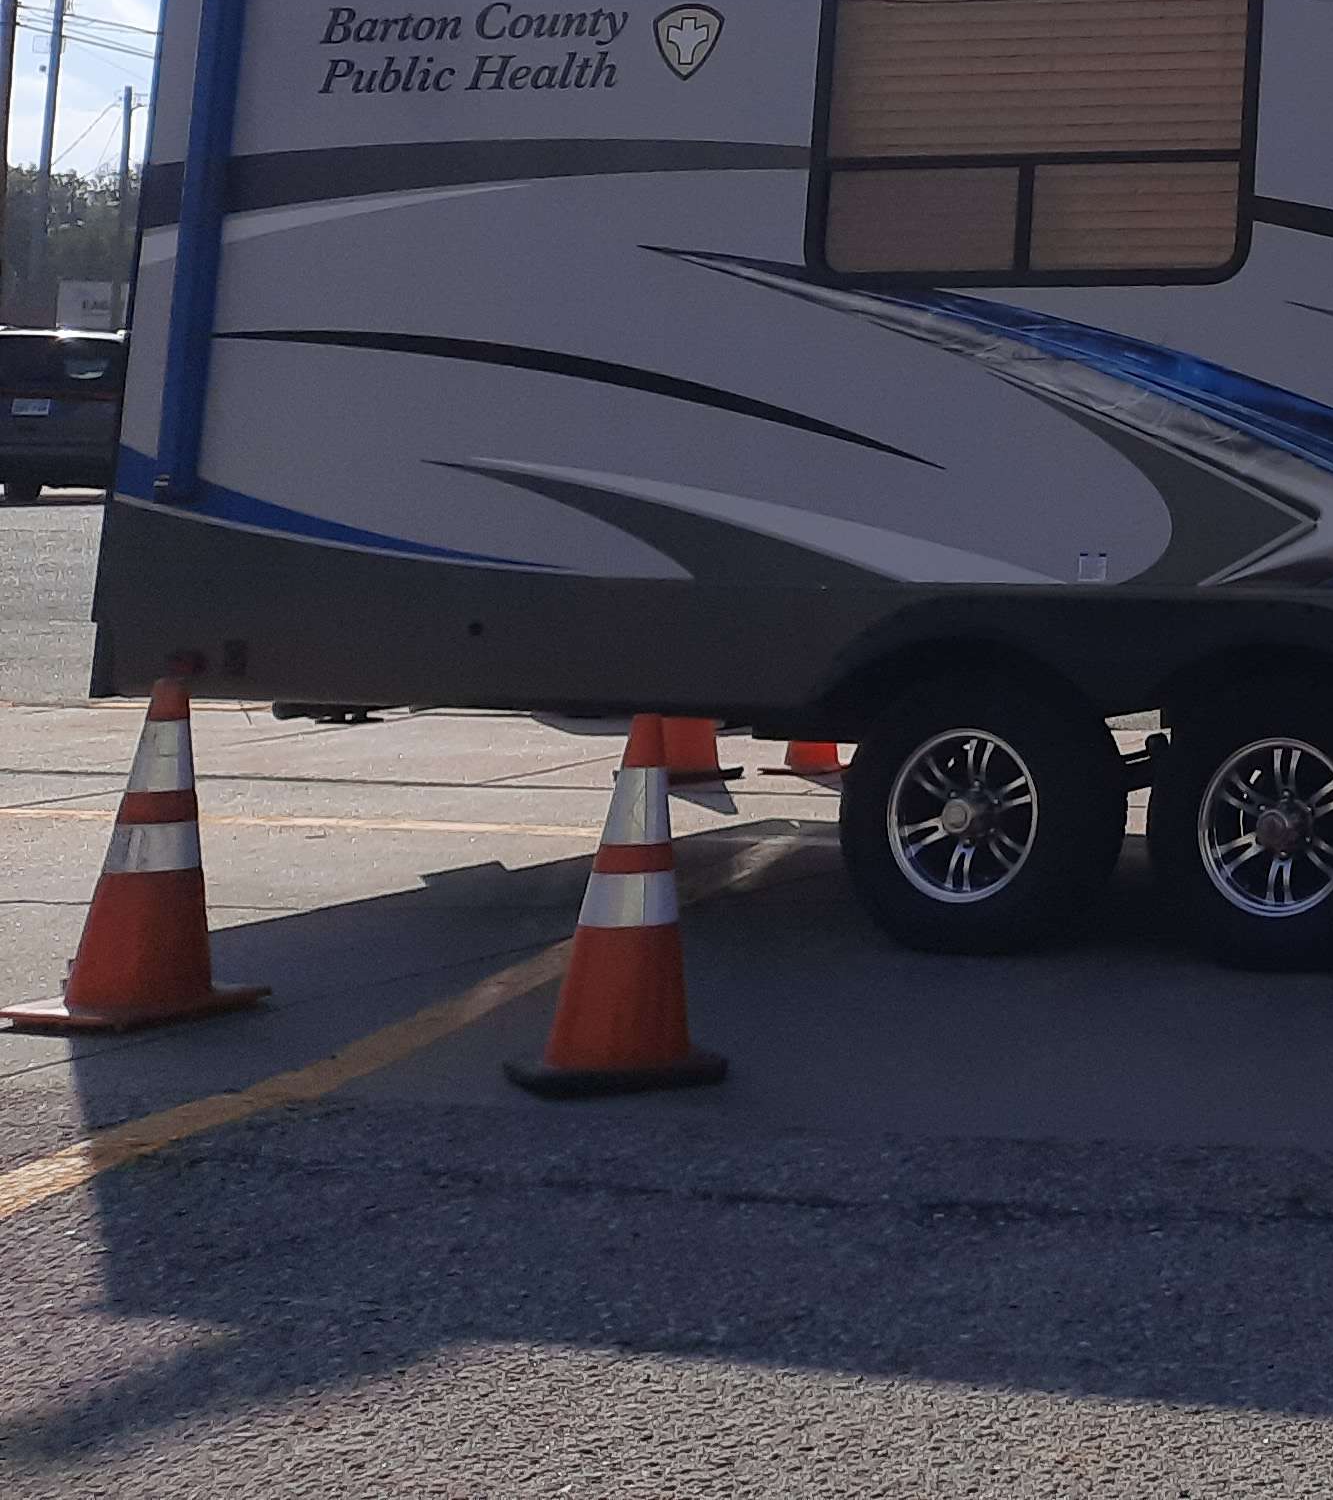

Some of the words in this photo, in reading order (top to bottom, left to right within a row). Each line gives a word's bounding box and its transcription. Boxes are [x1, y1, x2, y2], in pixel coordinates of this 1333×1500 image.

[319, 7, 464, 45] Barton
[474, 2, 630, 47] County
[317, 56, 456, 95] Public
[464, 51, 619, 92] Health
